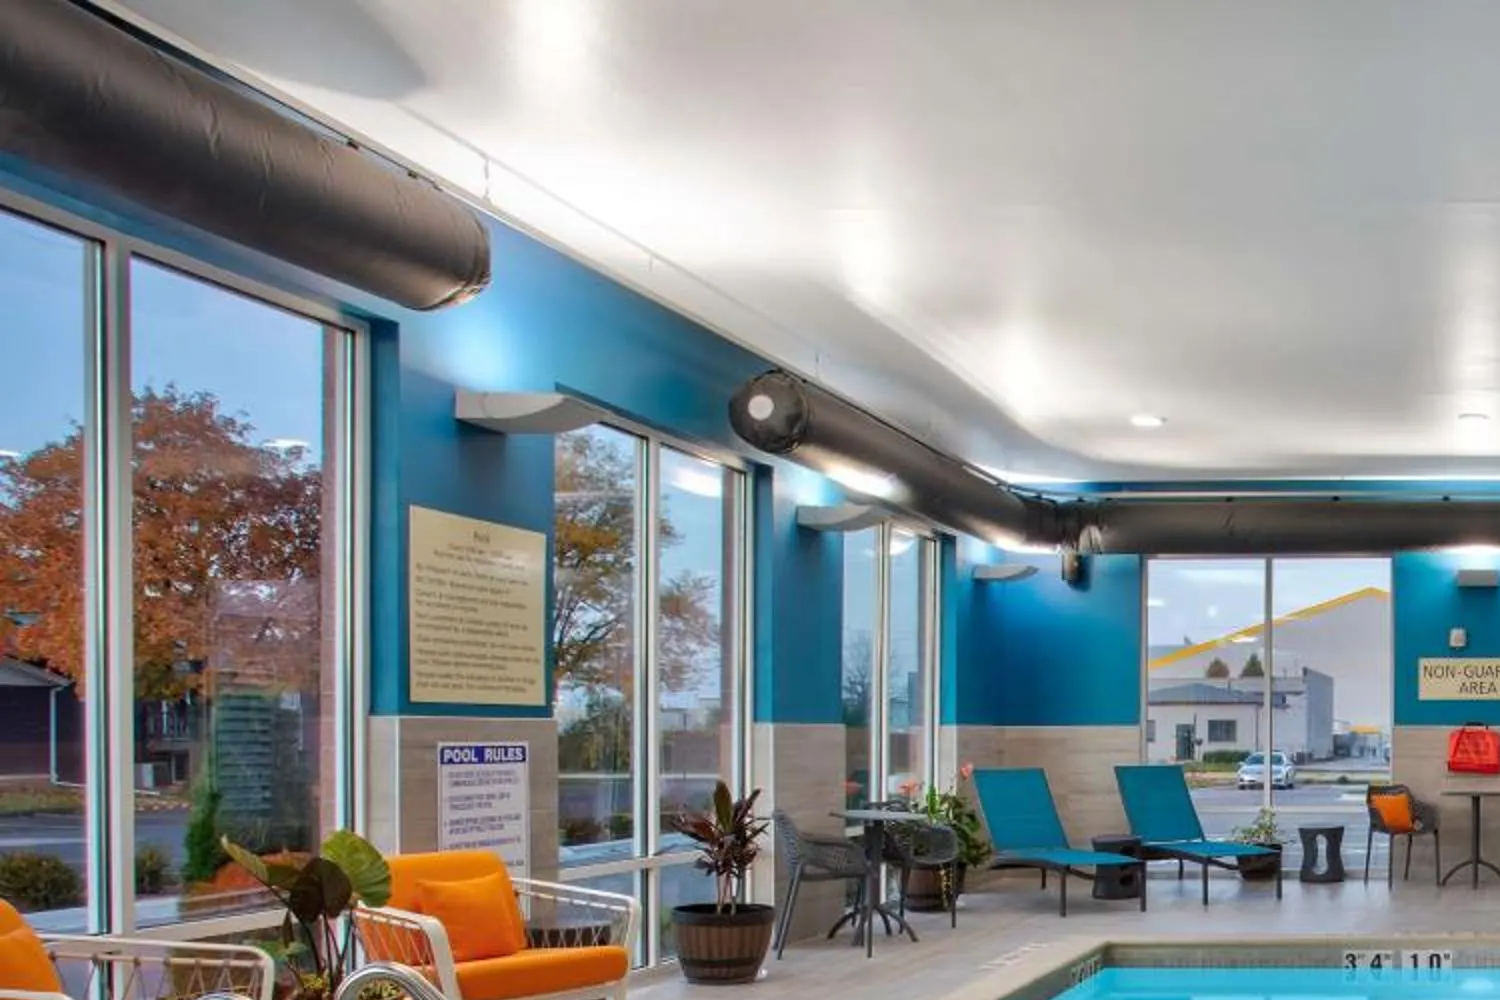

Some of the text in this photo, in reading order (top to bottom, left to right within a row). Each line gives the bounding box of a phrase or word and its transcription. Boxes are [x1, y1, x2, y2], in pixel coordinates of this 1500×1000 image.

[1459, 681, 1497, 695] AREA
[443, 747, 523, 763] POOL RULES
